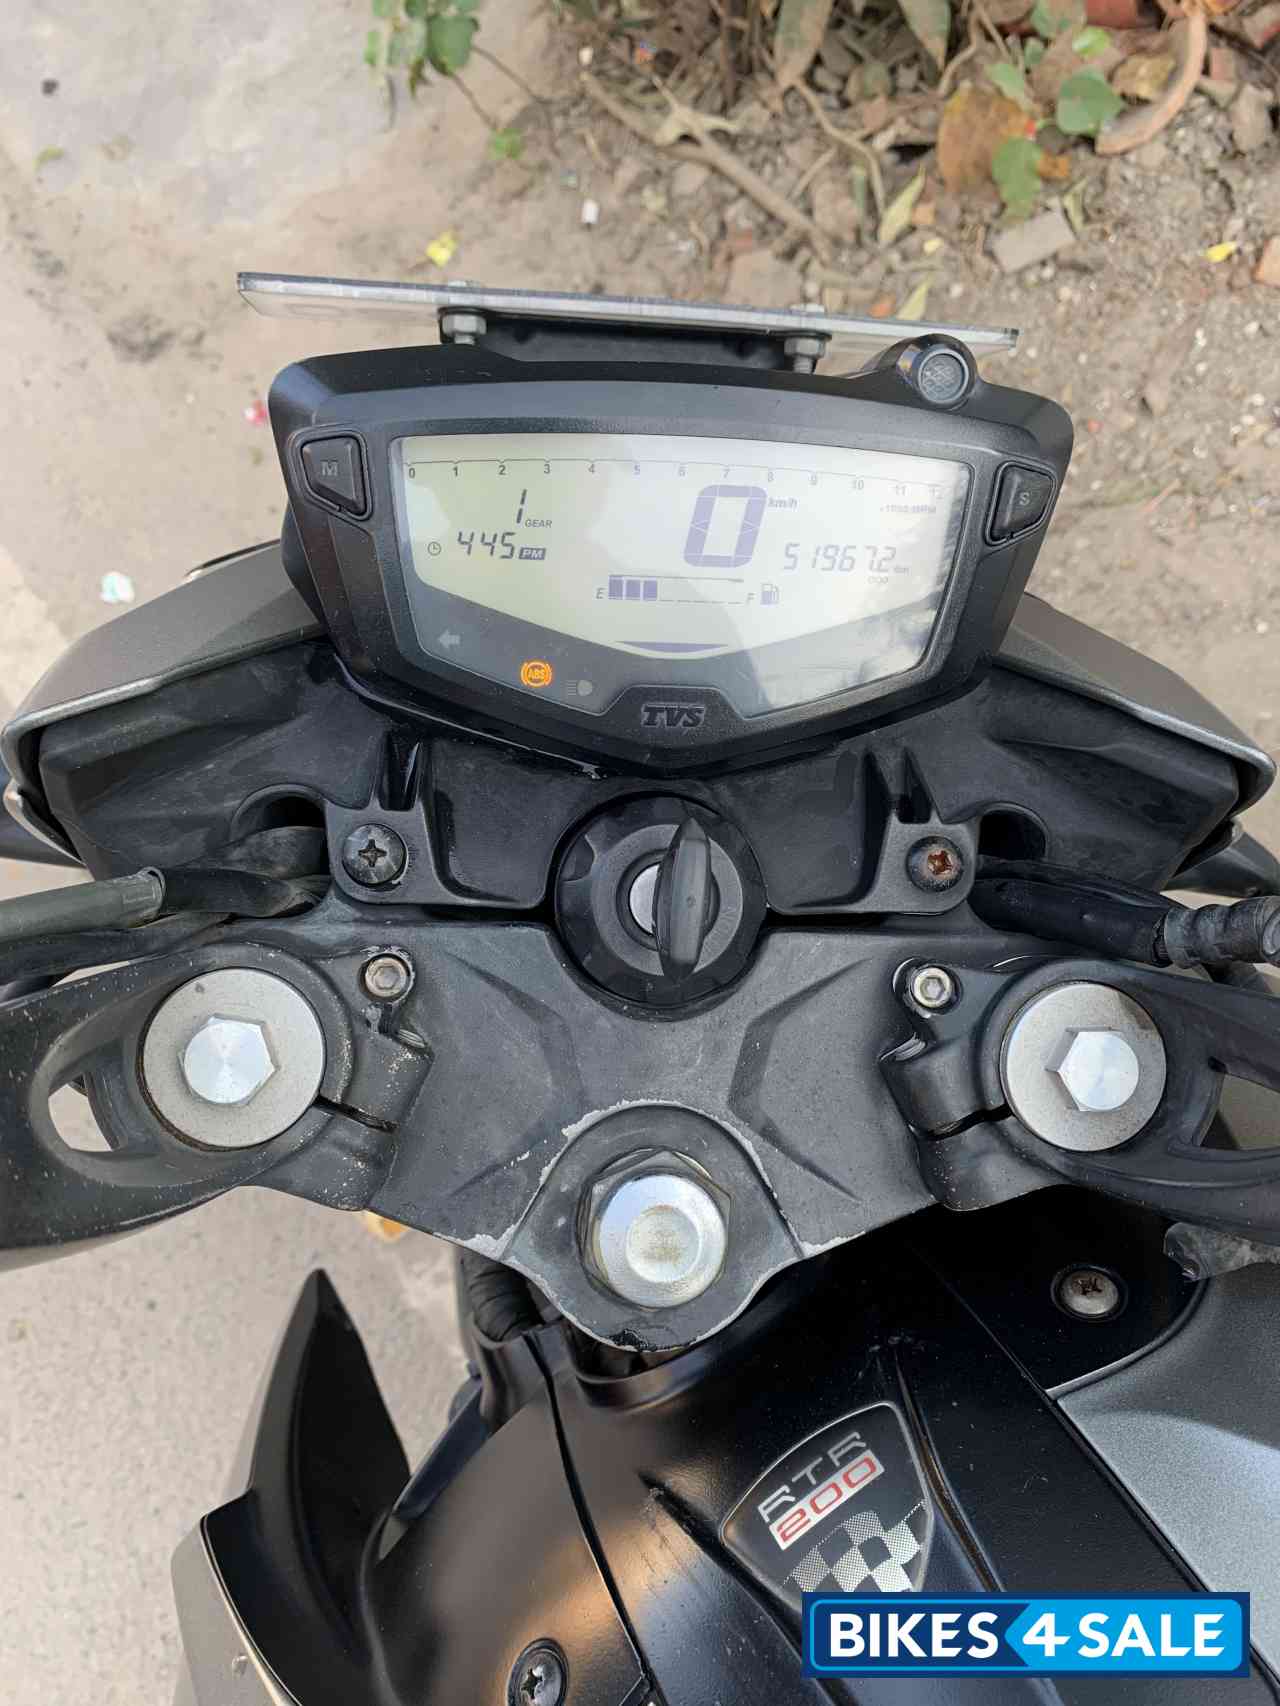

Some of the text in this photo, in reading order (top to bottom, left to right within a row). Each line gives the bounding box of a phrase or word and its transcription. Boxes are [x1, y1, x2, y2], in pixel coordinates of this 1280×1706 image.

[408, 467, 416, 479] 0
[453, 466, 459, 477] 1
[499, 464, 506, 476] 2
[543, 464, 551, 475] 3
[588, 463, 596, 474] 4
[634, 465, 641, 475] 5
[516, 489, 527, 523] 1
[525, 519, 552, 528] GEAR
[684, 485, 767, 567] 0
[519, 548, 545, 559] PM
[596, 588, 605, 599] E
[527, 668, 545, 680] ABS
[641, 703, 705, 727] TVS
[758, 1432, 866, 1523] RTR
[776, 1456, 877, 1542] 200
